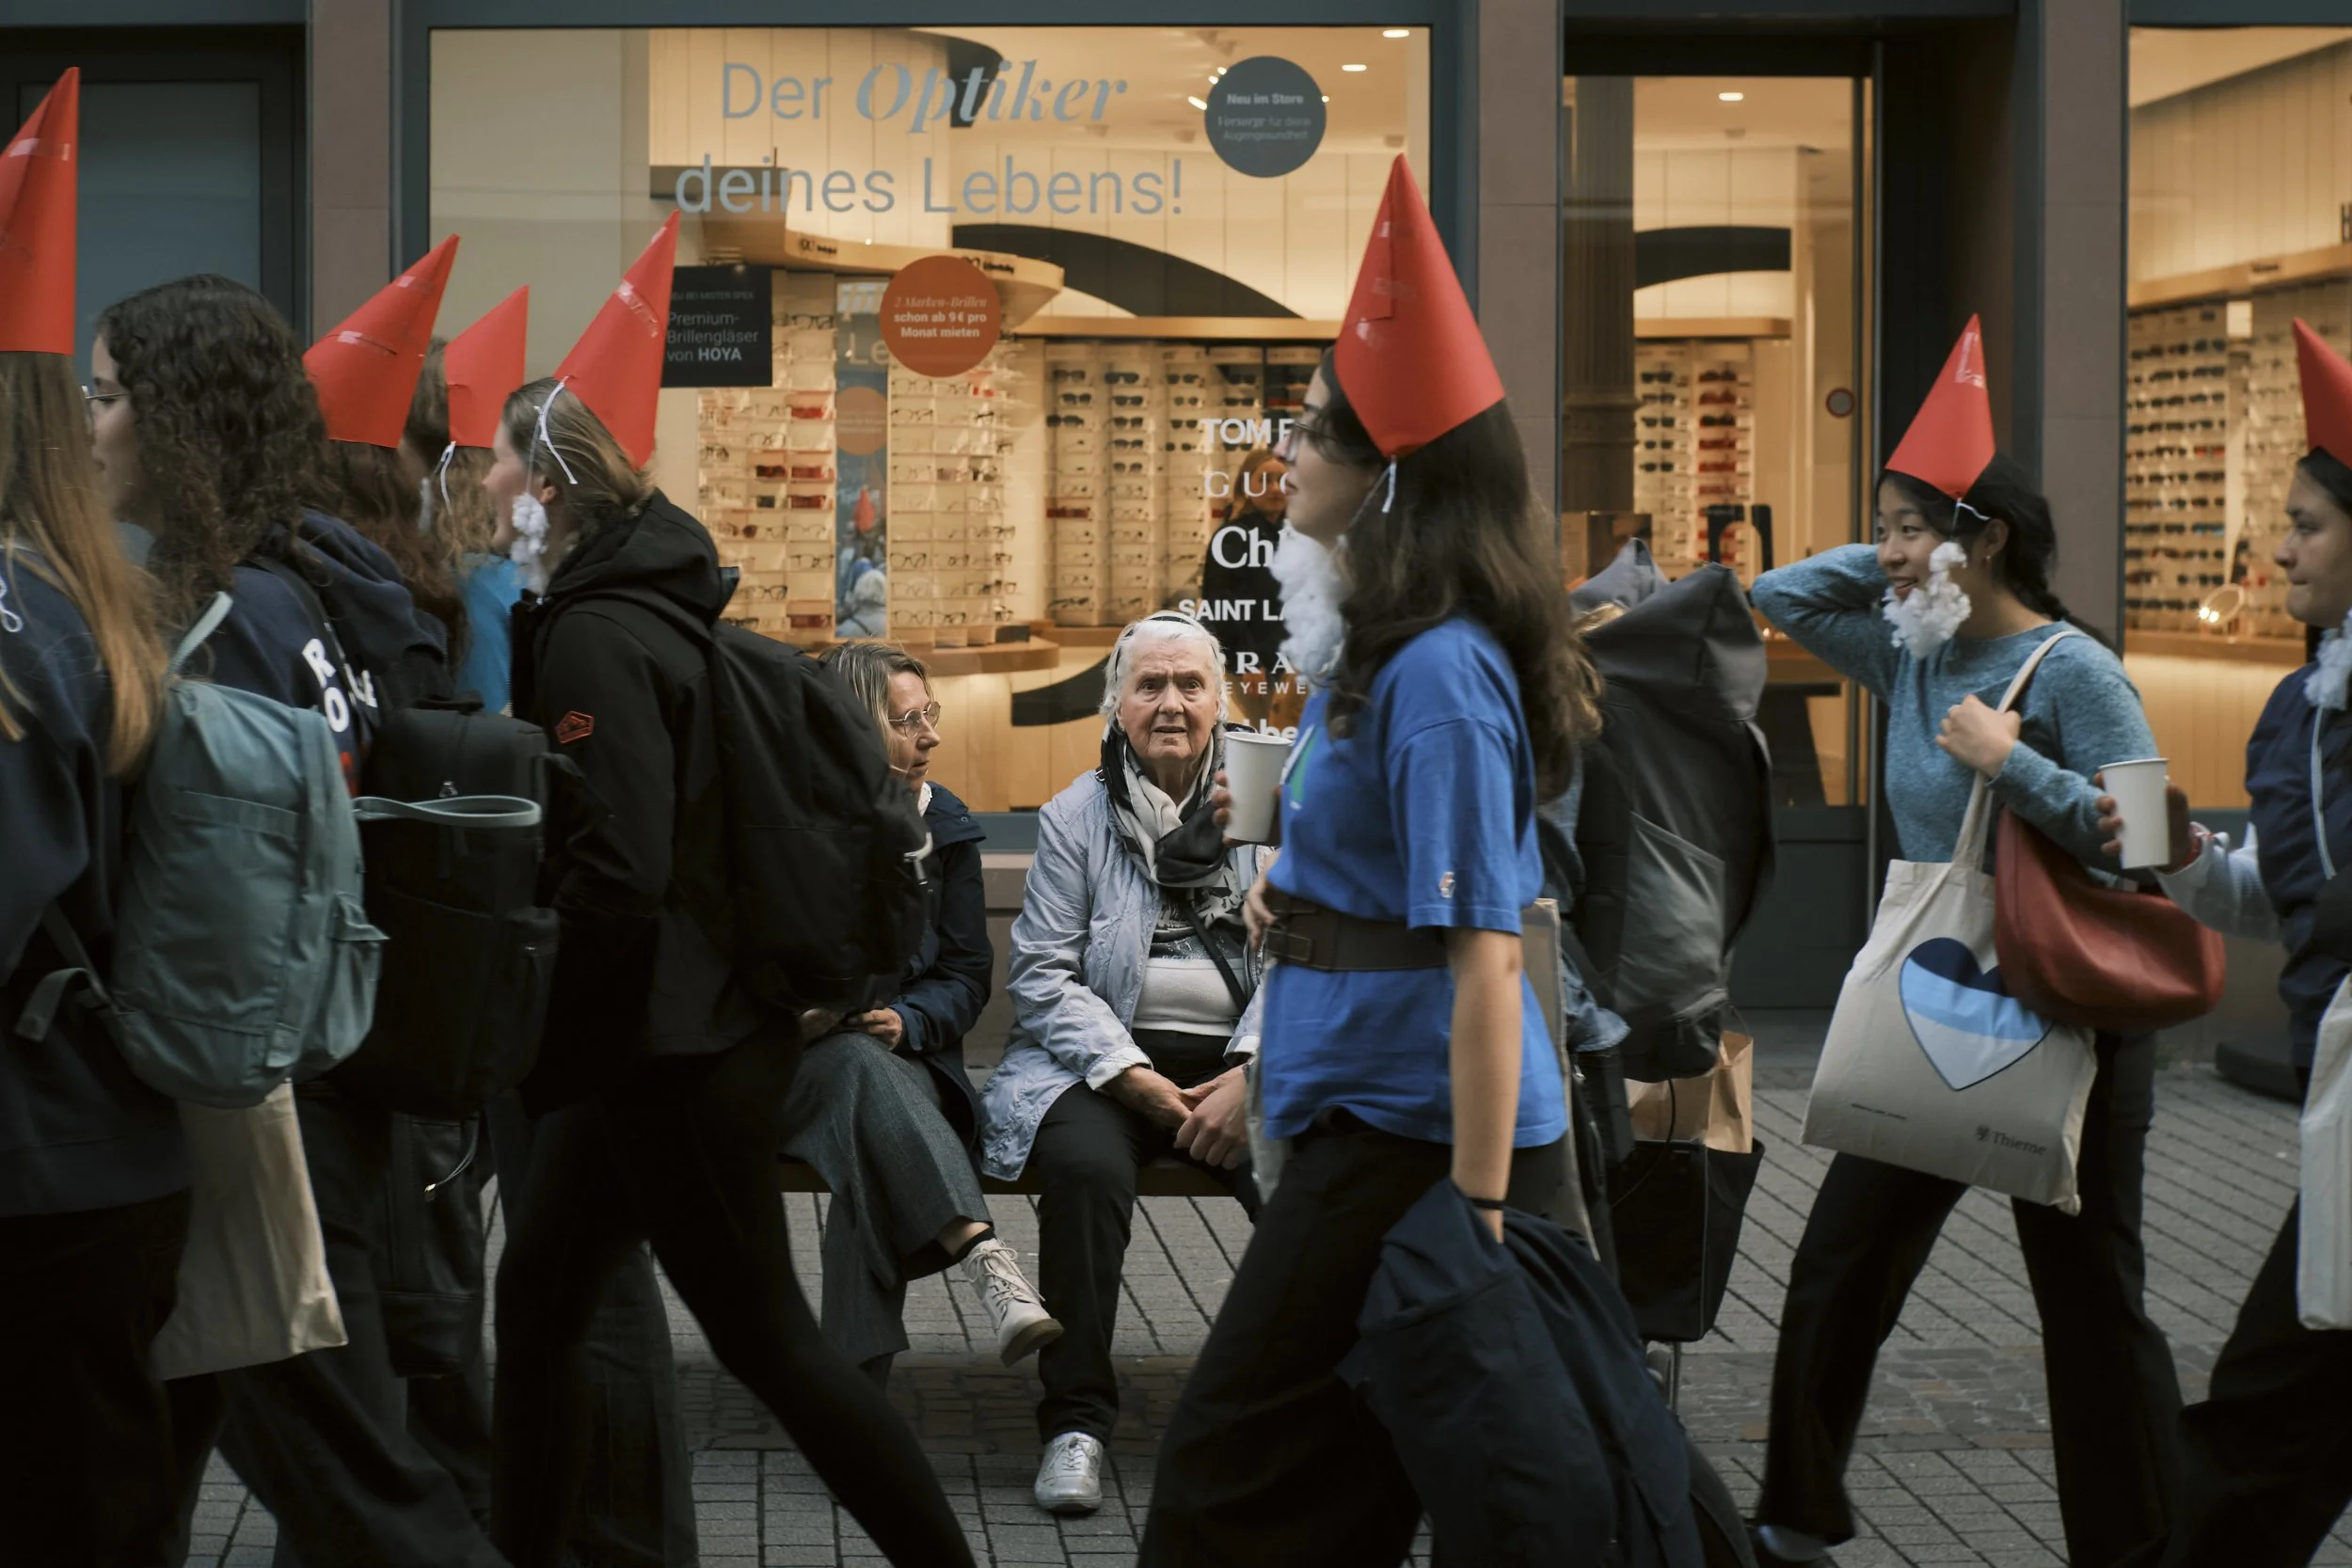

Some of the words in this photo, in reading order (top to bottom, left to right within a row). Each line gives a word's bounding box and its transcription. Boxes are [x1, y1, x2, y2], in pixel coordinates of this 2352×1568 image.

[723, 62, 834, 119] Der
[855, 59, 1128, 135] Optiker
[1227, 93, 1251, 104] Neu
[1271, 92, 1304, 105] Store
[675, 152, 896, 214] deines
[923, 155, 1182, 214] Lebens!
[894, 311, 929, 323] schon
[931, 311, 946, 323] ab
[967, 313, 987, 325] pro
[667, 328, 759, 346] Brillengläser
[900, 326, 937, 338] Monat
[941, 326, 980, 338] mieten
[667, 350, 693, 361] von
[698, 347, 742, 361] HOYA
[1200, 418, 1272, 445] TOM
[1211, 525, 1281, 568] Ch
[1178, 599, 1256, 621] SAINT
[1222, 651, 1296, 674] RA
[1992, 1131, 2047, 1156] Thieme
